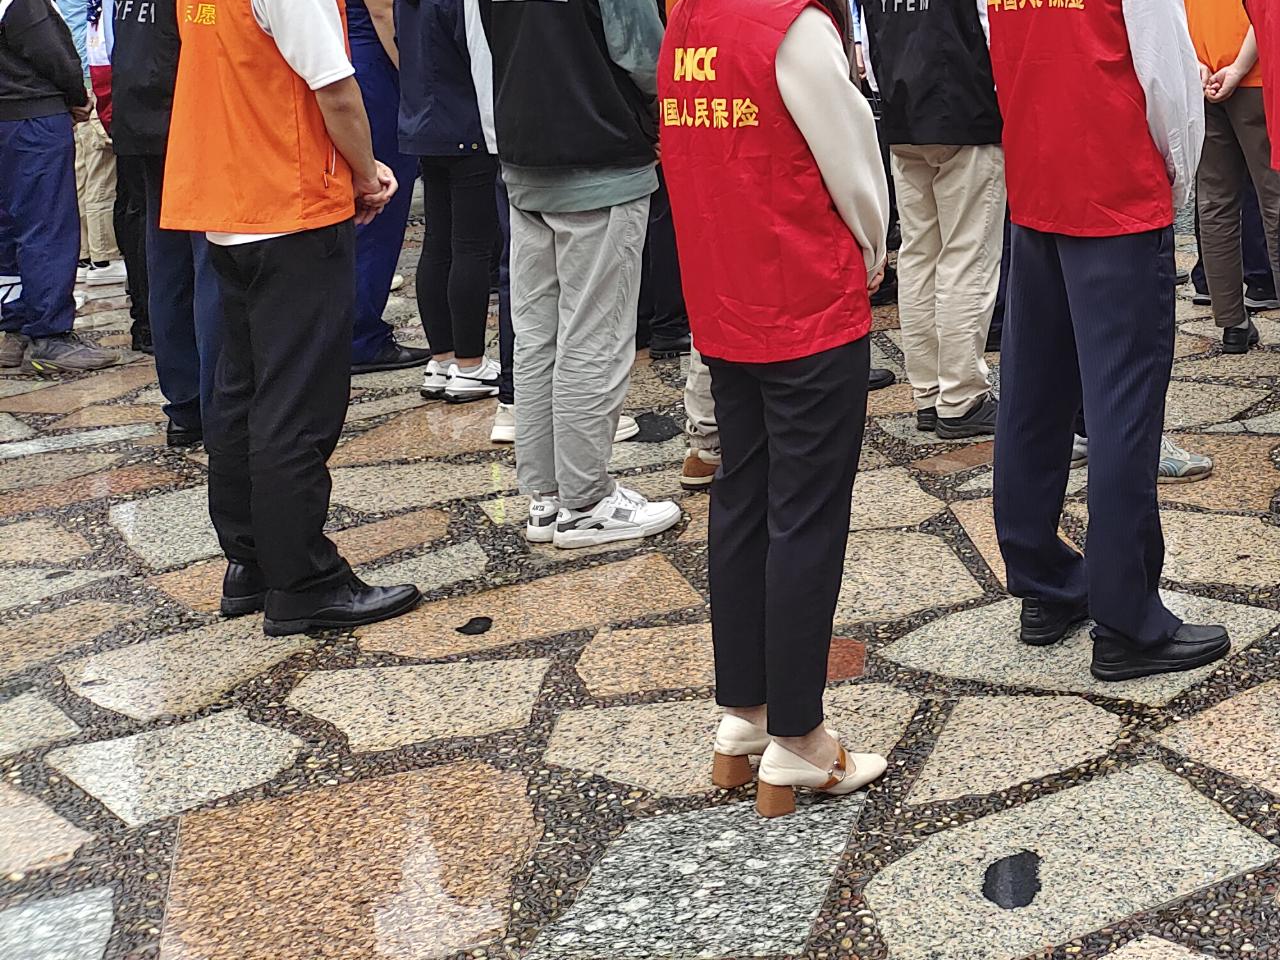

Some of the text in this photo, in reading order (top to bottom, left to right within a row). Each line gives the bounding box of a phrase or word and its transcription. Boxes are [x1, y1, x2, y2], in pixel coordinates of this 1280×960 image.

[659, 97, 759, 129] 国人民保险
